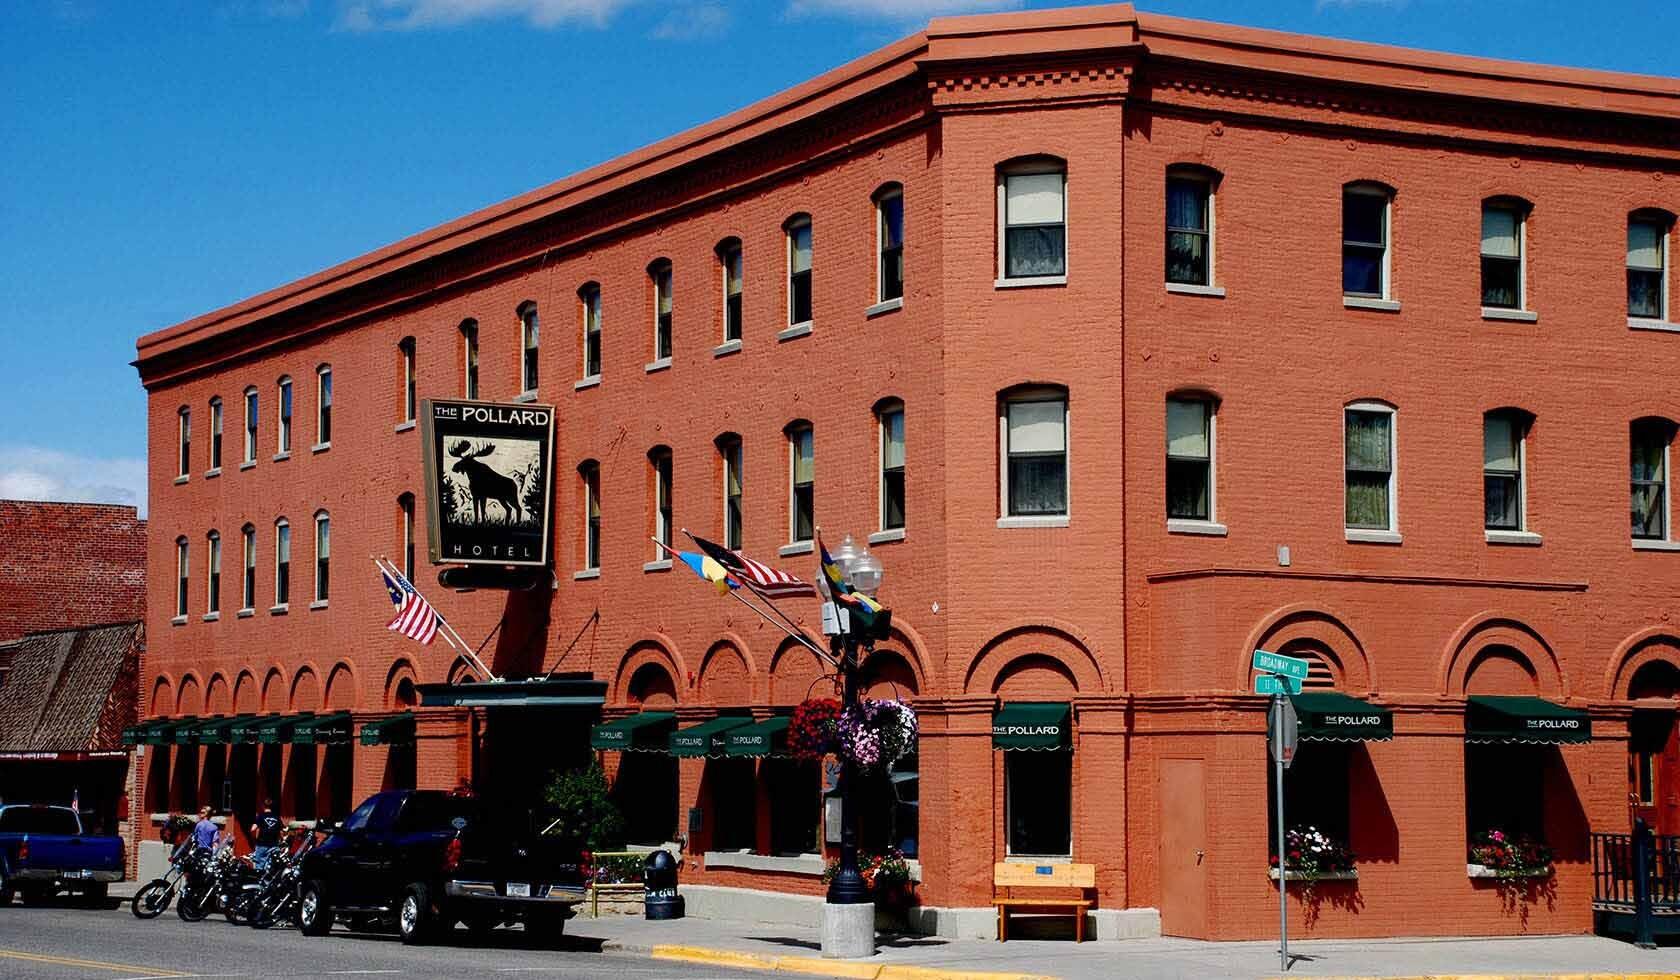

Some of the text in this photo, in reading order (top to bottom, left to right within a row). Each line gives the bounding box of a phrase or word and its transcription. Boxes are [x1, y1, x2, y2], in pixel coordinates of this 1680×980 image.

[435, 407, 549, 425] THE POLLARD
[454, 545, 530, 557] HOTEL
[1338, 716, 1381, 725] POLLARD
[1539, 720, 1579, 728] POLLARD
[1008, 726, 1060, 735] POLLARD
[682, 737, 703, 746] POLLARD
[740, 736, 762, 745] POLLARD
